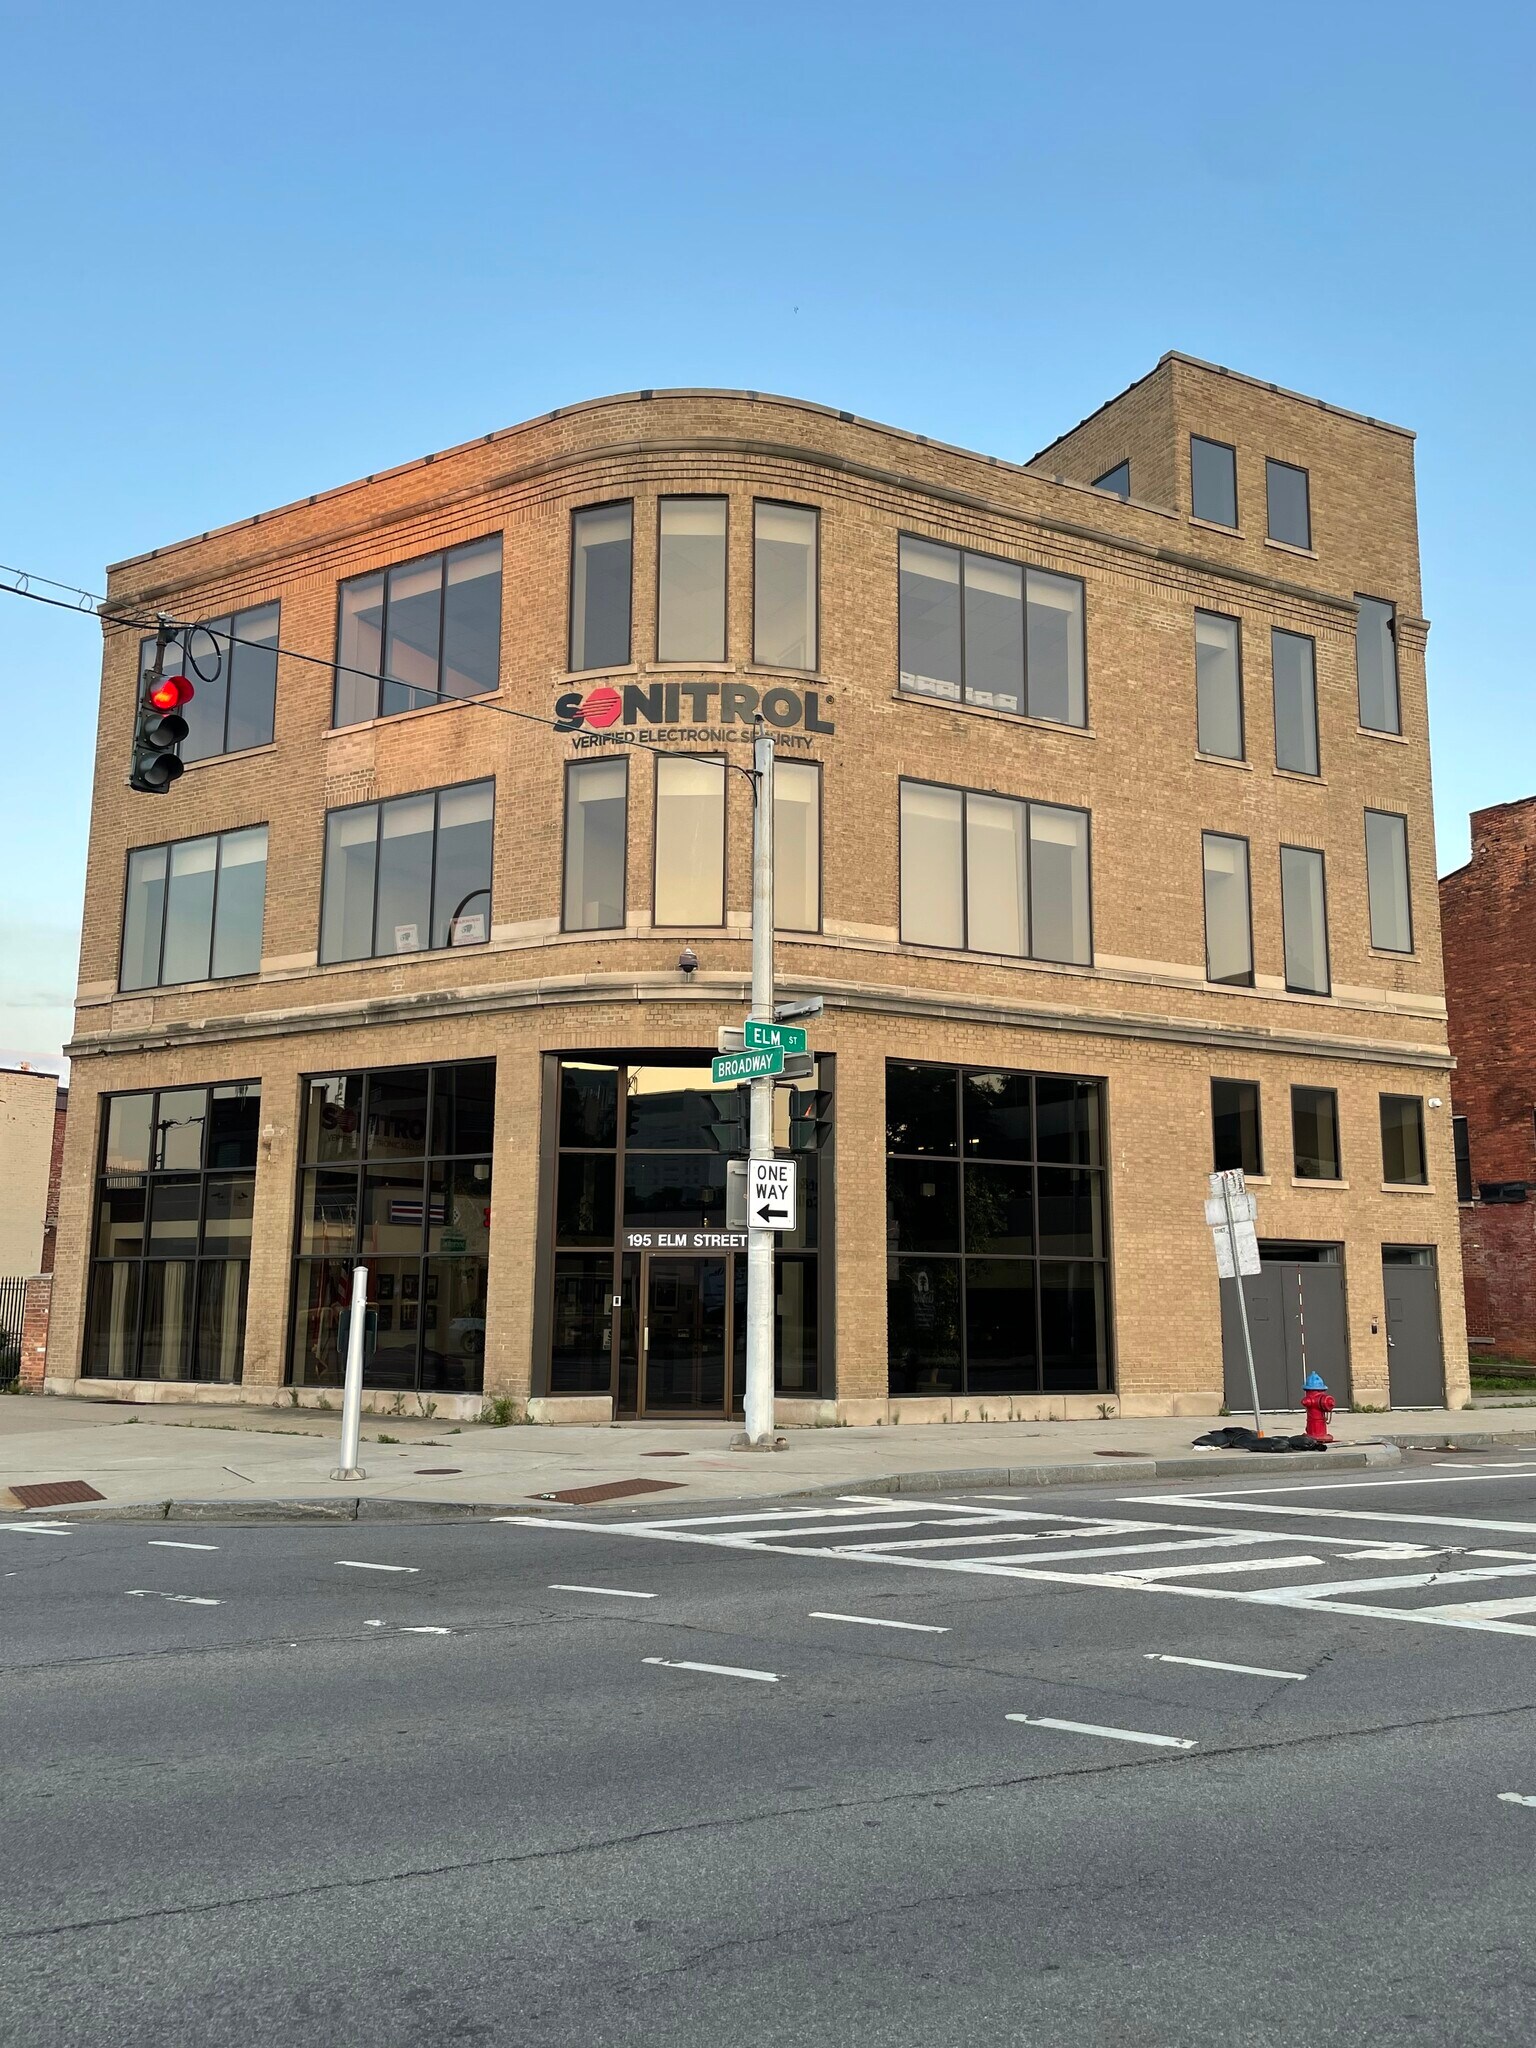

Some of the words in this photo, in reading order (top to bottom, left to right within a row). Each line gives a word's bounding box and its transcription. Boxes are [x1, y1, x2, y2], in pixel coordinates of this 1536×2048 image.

[572, 731, 635, 750] VERIFIED
[638, 729, 738, 745] ELECTRONIC
[754, 1028, 781, 1046] ELM
[788, 1035, 798, 1045] ST
[718, 1053, 774, 1078] BROADWAY
[757, 1165, 788, 1182] ONE
[756, 1184, 789, 1200] WAY
[627, 1234, 652, 1247] 195
[658, 1234, 687, 1247] ELM
[693, 1234, 748, 1247] STREET
